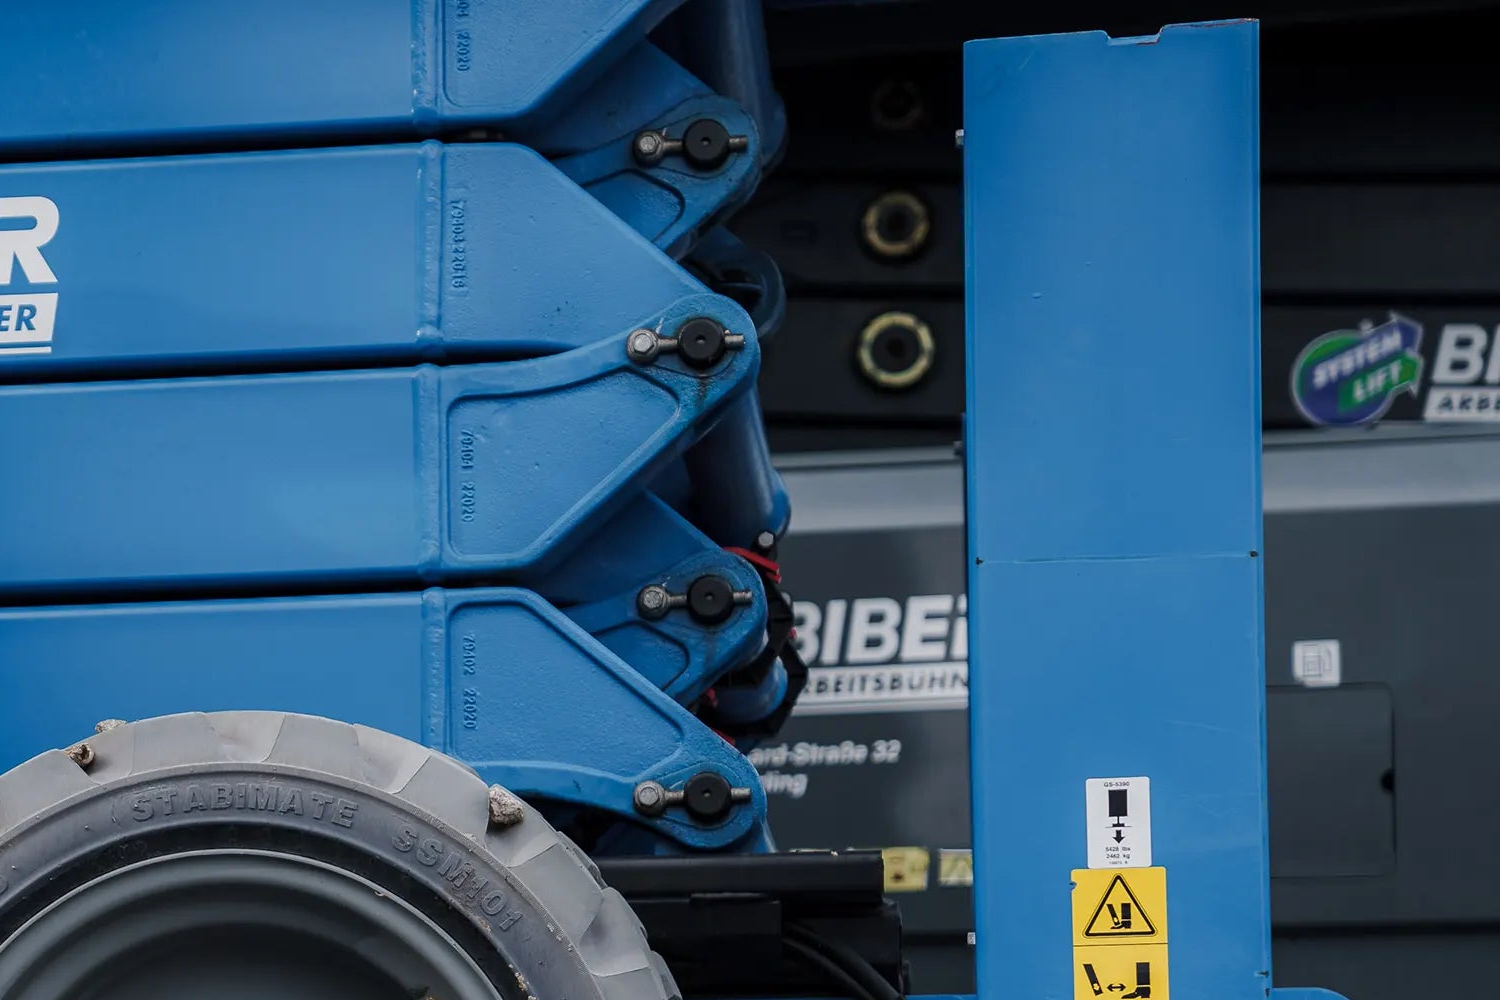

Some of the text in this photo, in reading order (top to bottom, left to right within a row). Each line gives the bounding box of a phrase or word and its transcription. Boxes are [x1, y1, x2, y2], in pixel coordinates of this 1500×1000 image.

[1313, 330, 1402, 403] SYSTEM LIFT
[871, 739, 902, 763] 32
[131, 782, 524, 931] STABIMATE SSM101
